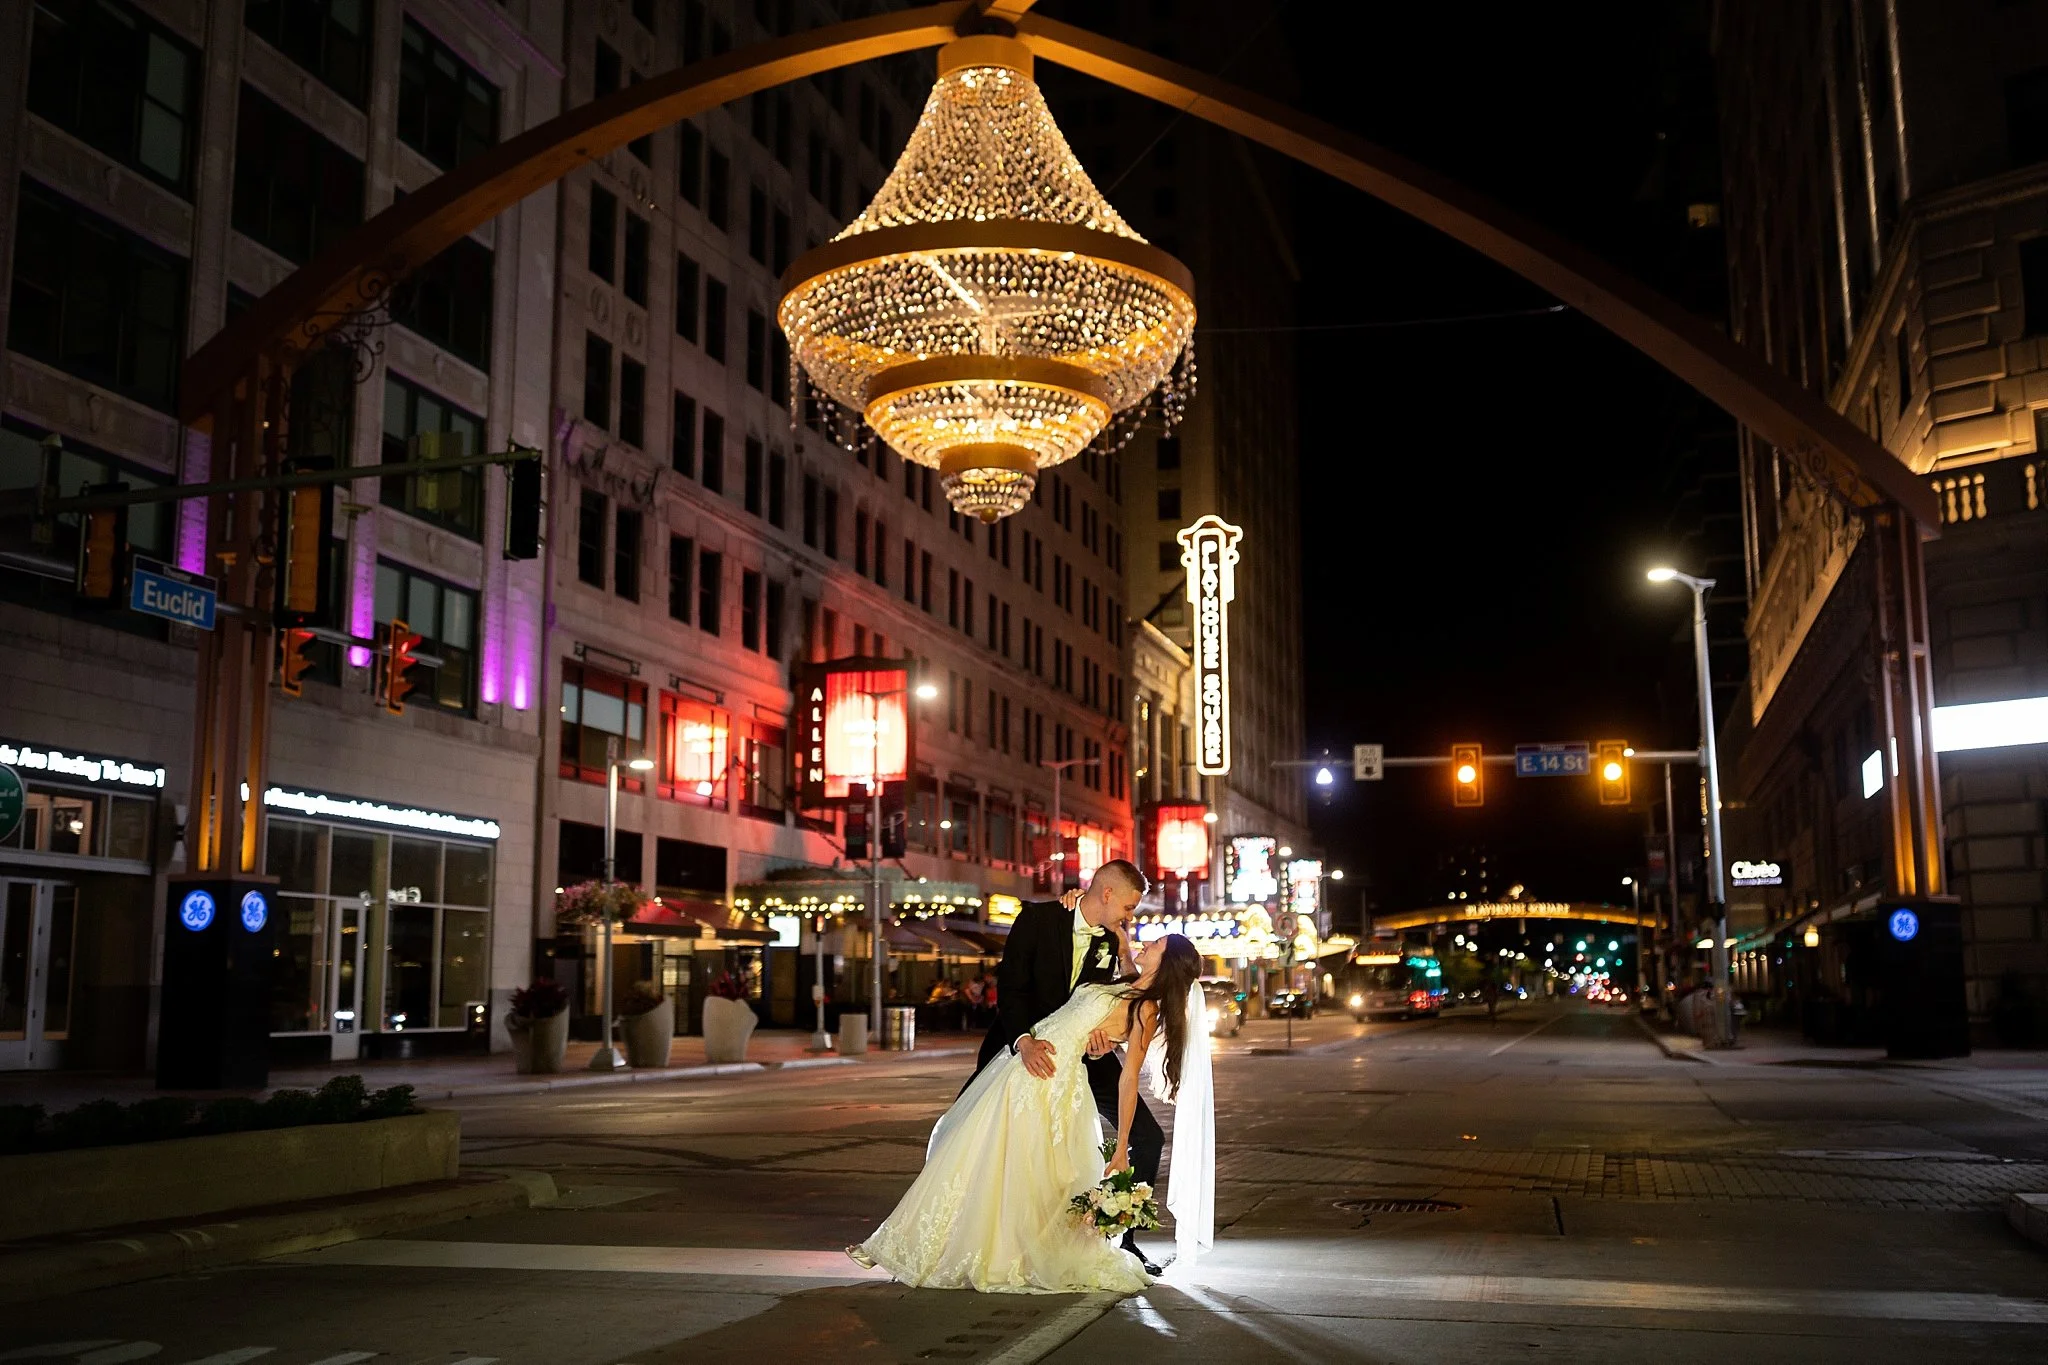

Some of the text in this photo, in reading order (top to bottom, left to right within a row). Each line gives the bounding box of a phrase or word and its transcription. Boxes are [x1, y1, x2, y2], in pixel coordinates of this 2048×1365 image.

[142, 579, 207, 621] Euclid
[1202, 540, 1221, 765] PLAYHOUSE SQUARE
[809, 687, 823, 782] ALLEN
[17, 747, 48, 770] Are
[47, 751, 102, 782] Racing
[100, 759, 121, 781] To
[1521, 754, 1584, 772] E. 14 St
[1464, 902, 1571, 917] PLAYHOUSE SQUARE
